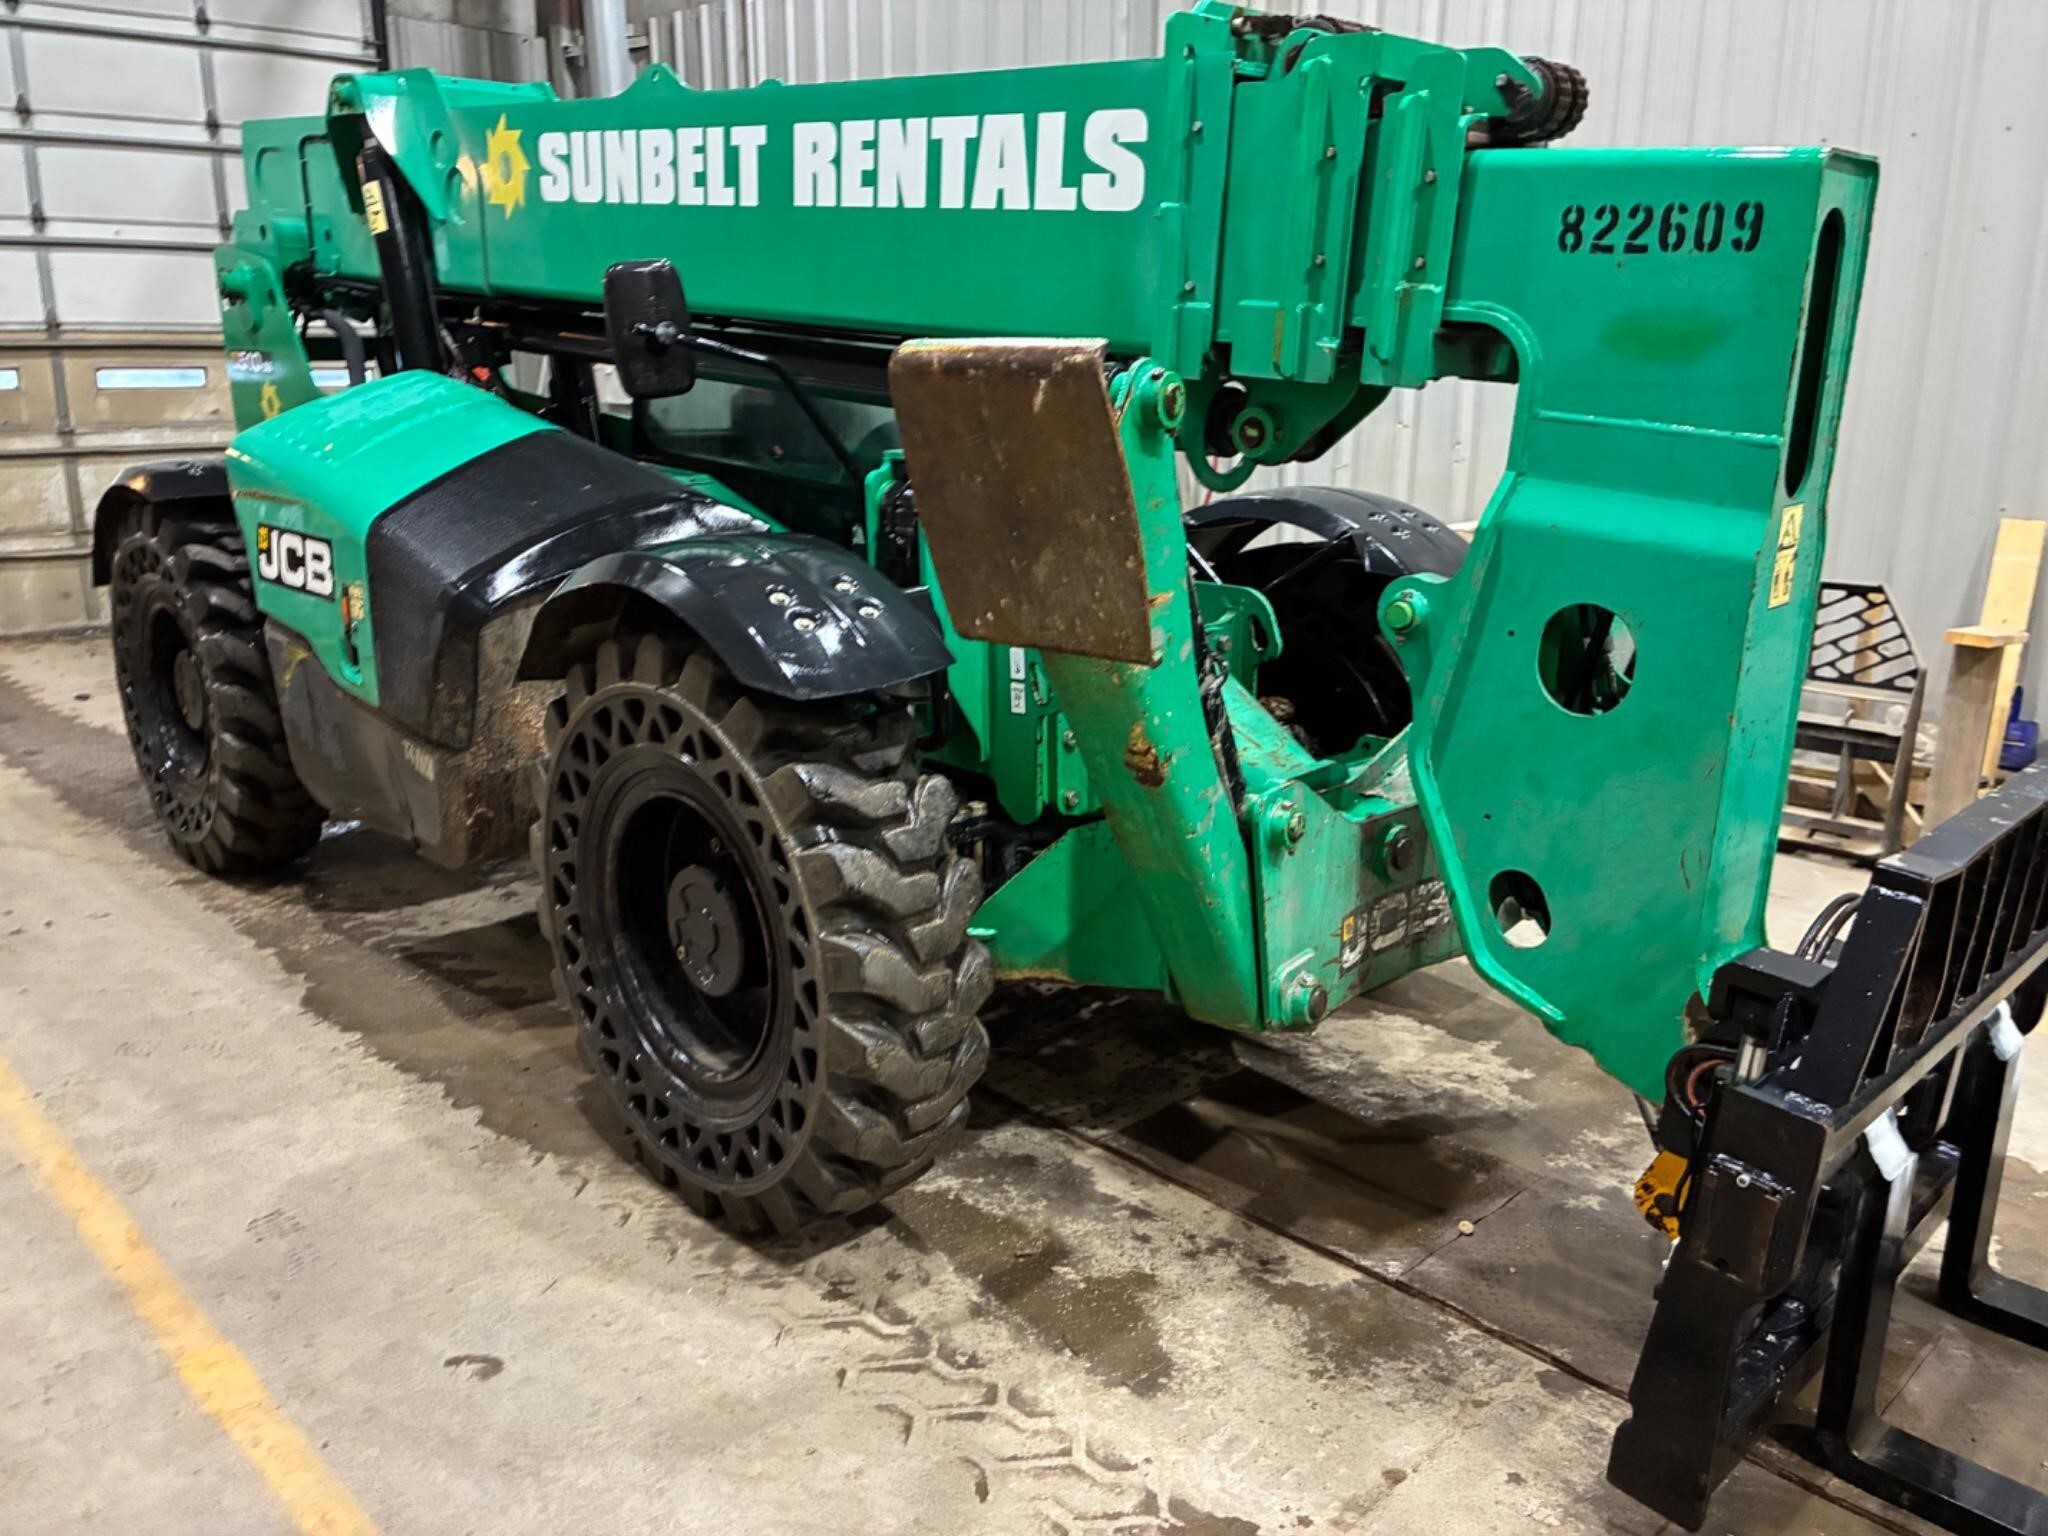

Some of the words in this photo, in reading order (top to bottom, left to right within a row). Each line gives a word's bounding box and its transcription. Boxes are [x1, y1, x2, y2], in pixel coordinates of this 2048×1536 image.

[538, 124, 767, 207] SUNBELT
[793, 108, 1149, 212] RENTALS
[1557, 201, 1765, 254] 822609
[259, 528, 334, 596] JCB
